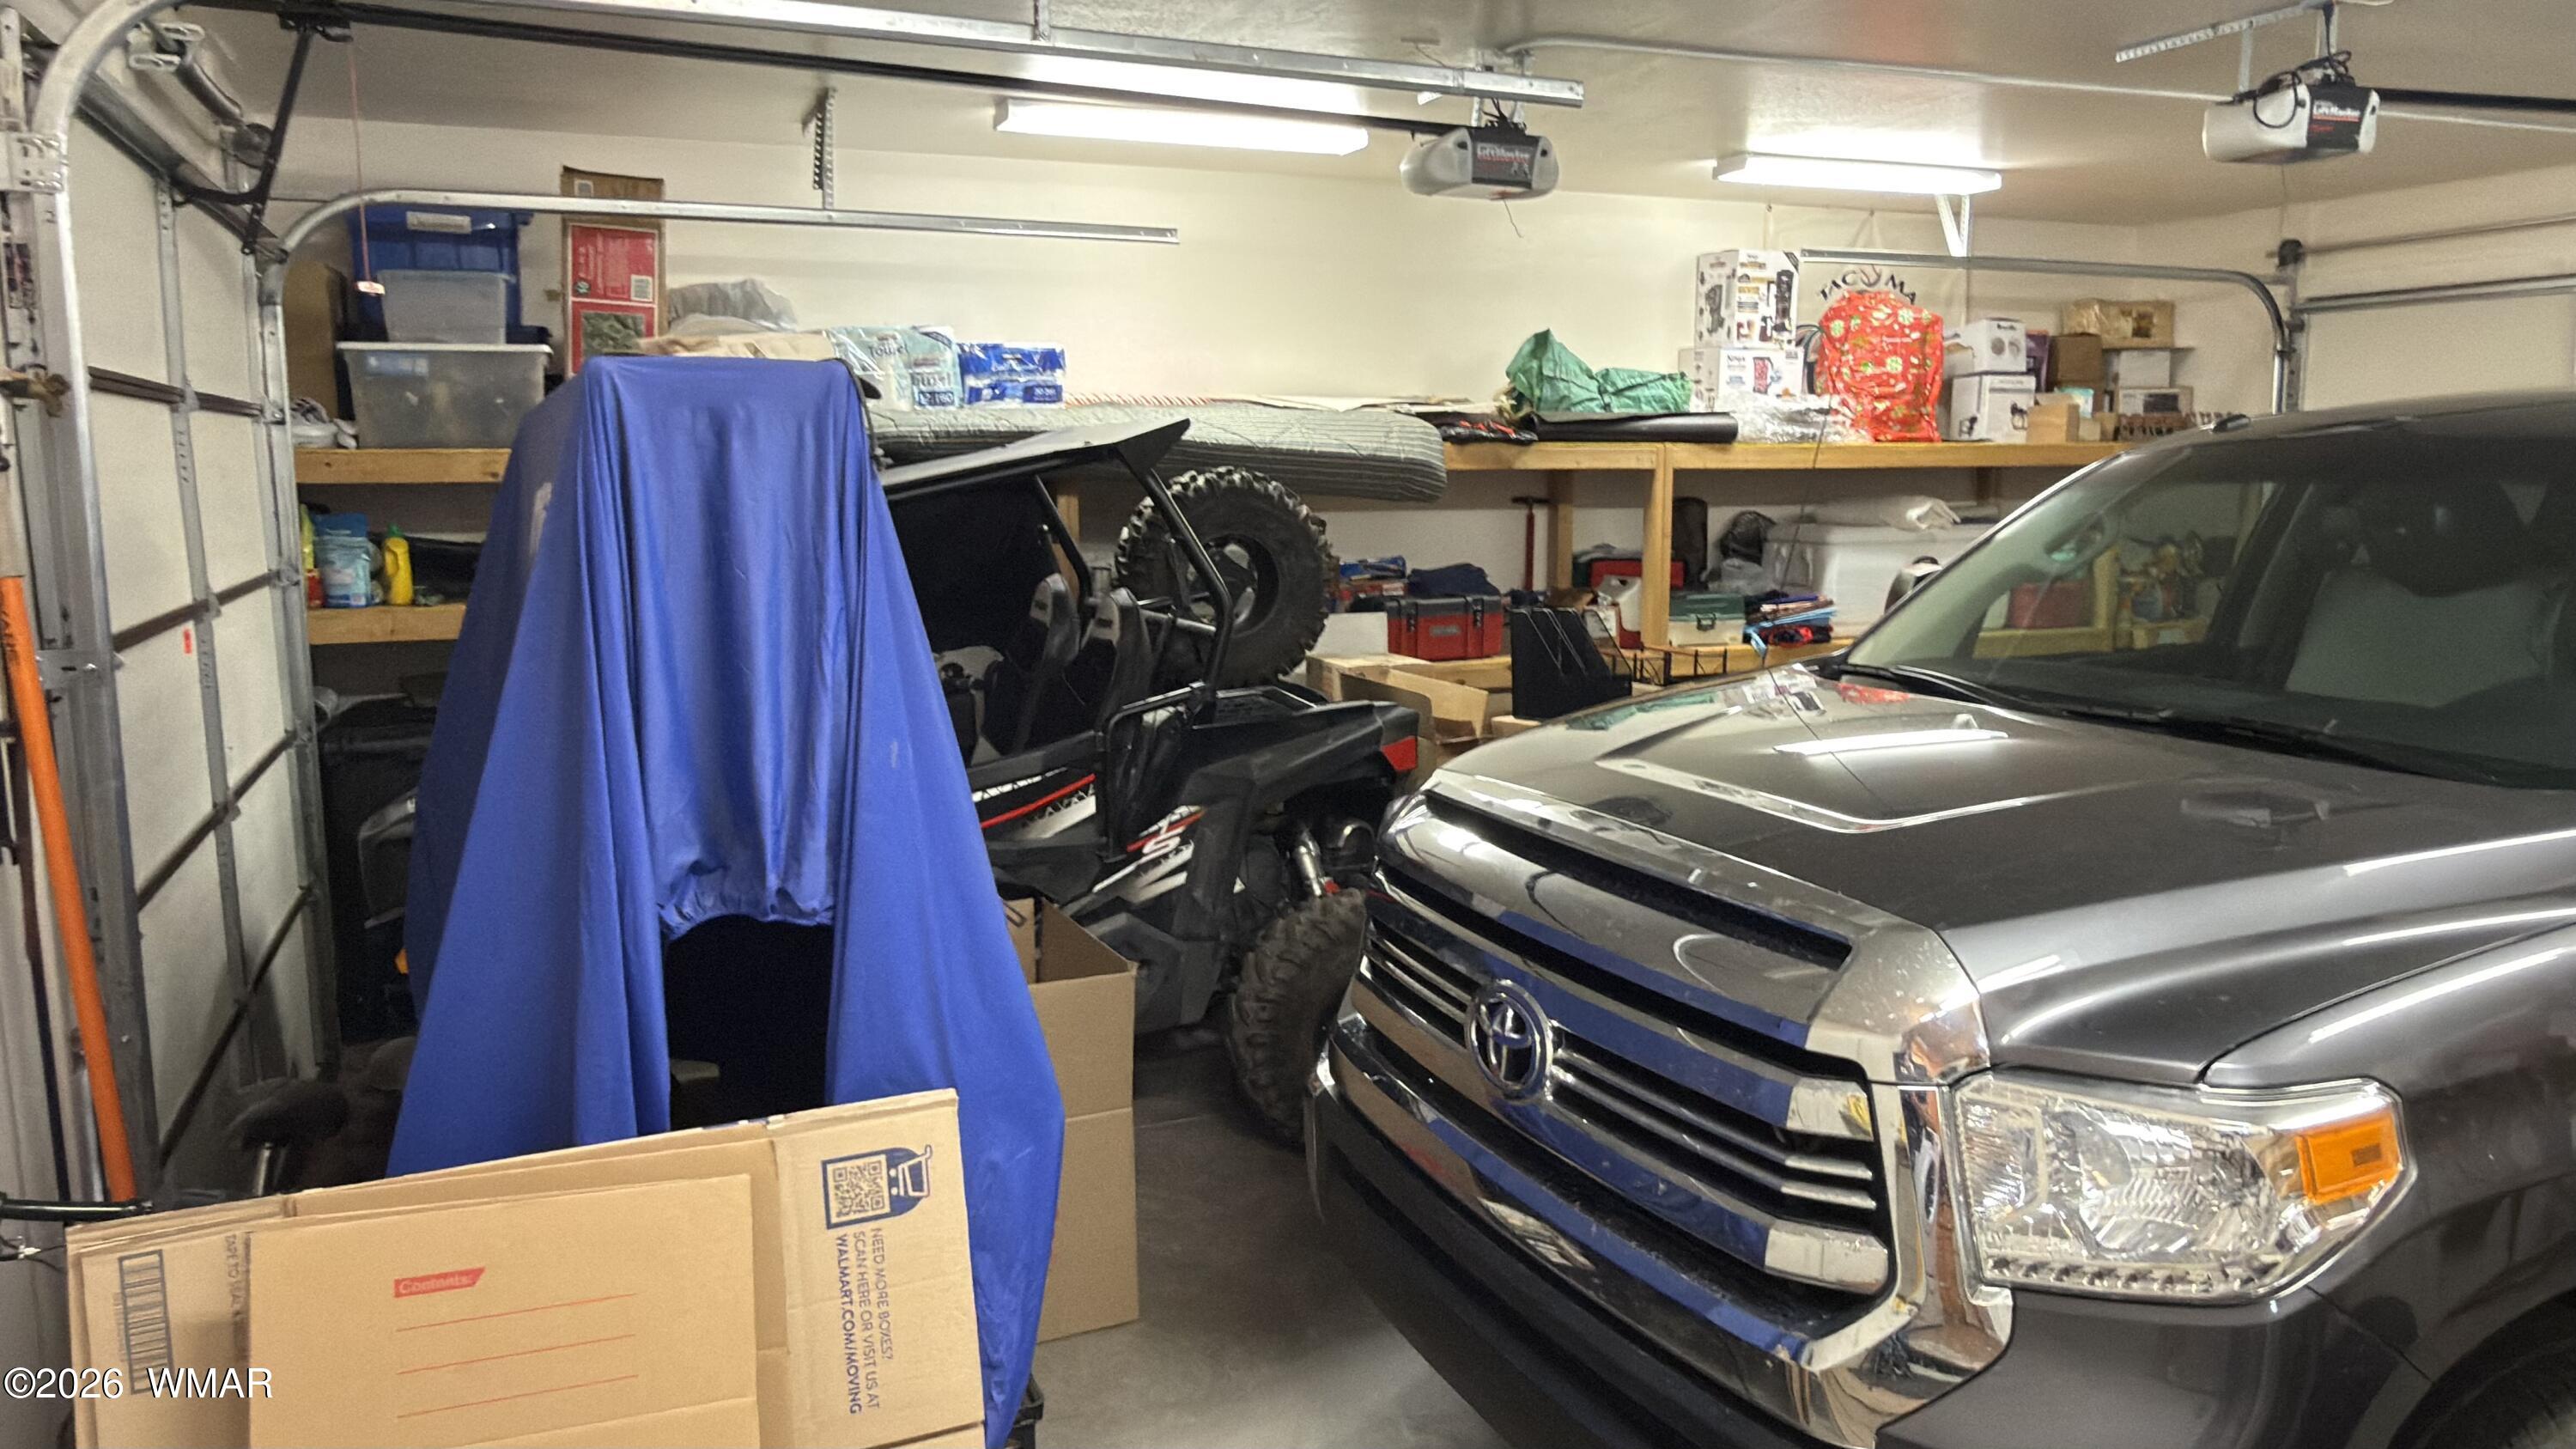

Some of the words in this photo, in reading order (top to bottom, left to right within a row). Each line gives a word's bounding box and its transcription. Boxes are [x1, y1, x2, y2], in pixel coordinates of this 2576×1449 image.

[853, 1230, 868, 1269] SCAN
[870, 1227, 885, 1264] NEED
[856, 1271, 872, 1308] HERE
[874, 1269, 890, 1309] MORE
[835, 1233, 863, 1414] WALMART.COM/MOVING
[860, 1310, 873, 1332] OR
[861, 1334, 877, 1367] VISIT
[865, 1371, 878, 1391] US
[866, 1392, 880, 1409] AT
